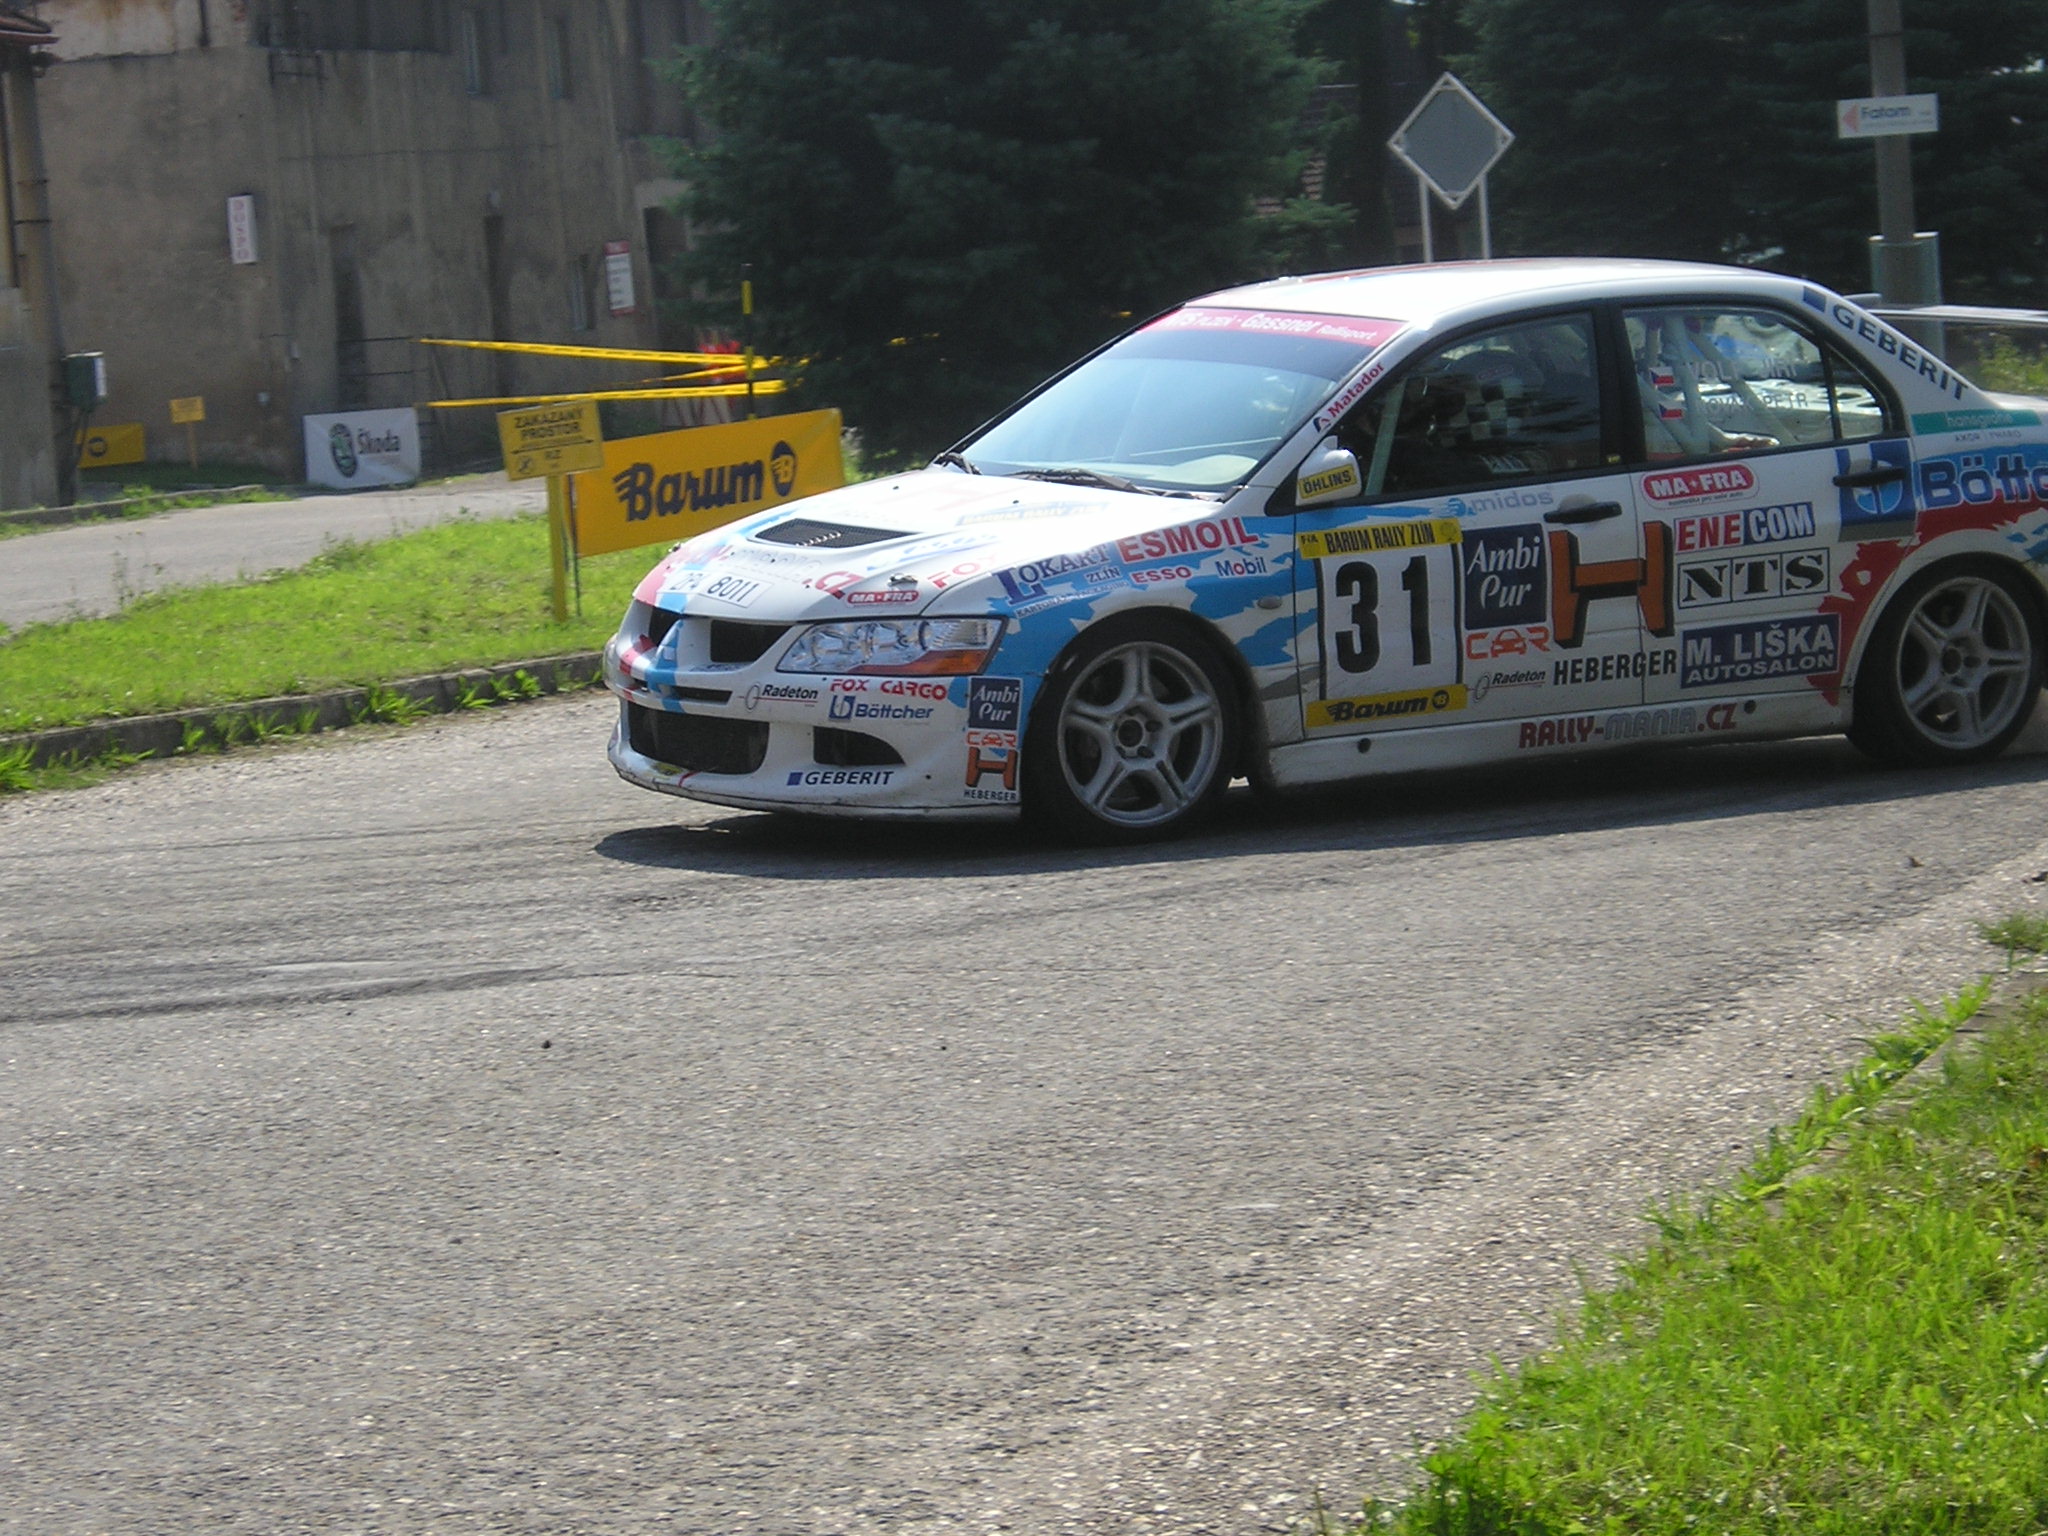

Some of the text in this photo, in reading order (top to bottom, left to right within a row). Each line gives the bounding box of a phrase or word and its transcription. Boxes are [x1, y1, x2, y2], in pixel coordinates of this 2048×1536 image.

[1833, 303, 1968, 400] GEBERIT
[1327, 362, 1385, 418] Matador
[612, 459, 764, 521] Barum
[1303, 470, 1351, 494] ÖHLINS
[1115, 517, 1260, 564] ESMOIL
[1325, 528, 1371, 553] BARUM
[1372, 524, 1406, 548] RALLY
[1409, 520, 1436, 545] ZLÍN
[1214, 556, 1267, 578] Mobil
[1466, 536, 1542, 575] Ambi
[707, 576, 760, 602] 8011
[992, 544, 1112, 605] LOKART
[1086, 565, 1121, 584] ZLÍN
[1132, 566, 1192, 584] ESSO
[1681, 555, 1825, 603] NTS
[1481, 573, 1532, 609] Pur
[1335, 555, 1432, 674] 31
[1687, 622, 1835, 666] M. LIŠKA
[1492, 669, 1547, 685] Radeton
[1553, 649, 1678, 686] HEBERGER
[1686, 653, 1835, 684] AUTOSALON
[762, 684, 818, 700] Radeton
[830, 678, 947, 700] FOX CARGO
[972, 684, 1020, 703] Ambi
[854, 704, 934, 719] Böttcher
[1327, 695, 1428, 722] Barum
[805, 771, 894, 786] GEBERIT
[964, 788, 1017, 801] HEBERGER
